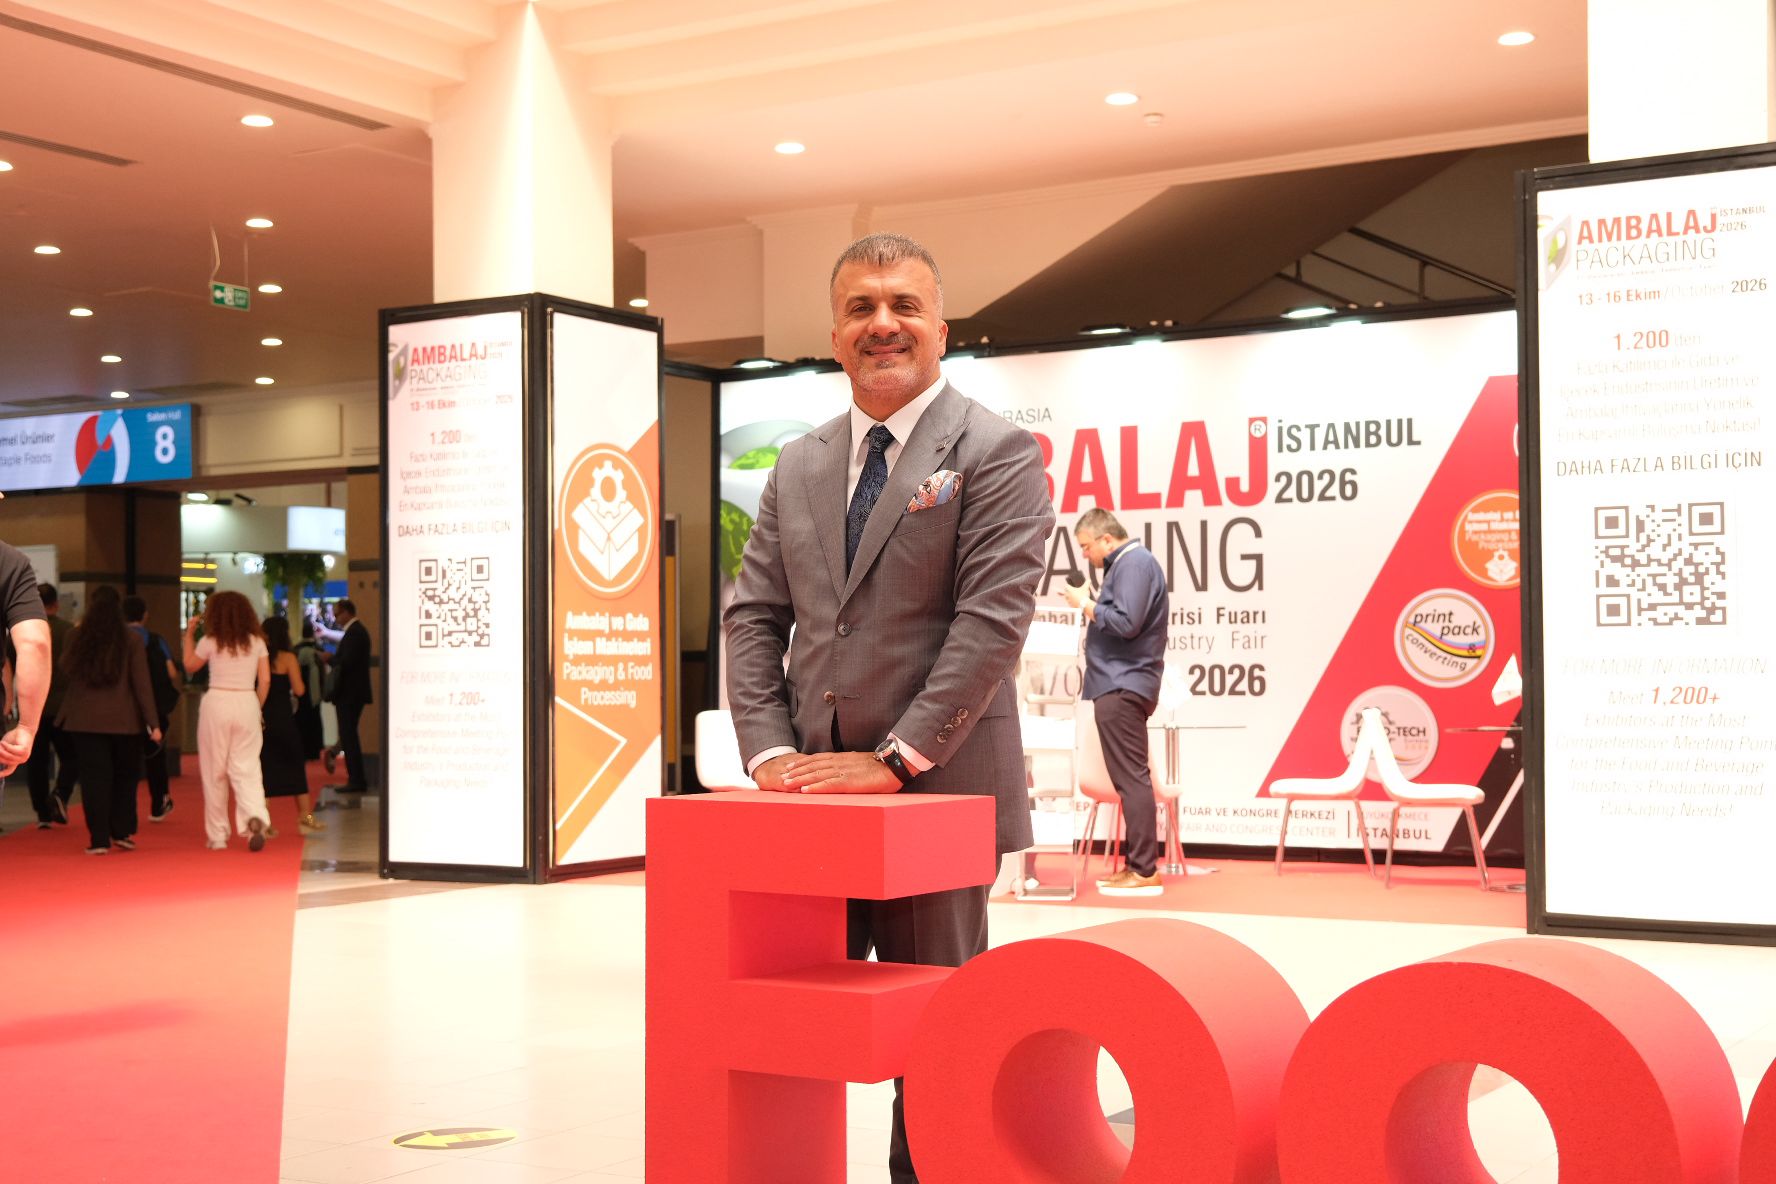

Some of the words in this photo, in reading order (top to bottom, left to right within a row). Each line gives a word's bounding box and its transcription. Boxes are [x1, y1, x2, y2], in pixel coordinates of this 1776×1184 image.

[1577, 209, 1717, 245] AMBALAJ
[1719, 221, 1747, 233] 2026
[1576, 237, 1716, 271] PACKAGING
[1577, 292, 1594, 306] 13
[1606, 290, 1622, 304] 16
[1731, 277, 1767, 294] 2026
[1614, 329, 1670, 351] 1.200
[411, 342, 488, 366] AMBALAJ
[1000, 407, 1053, 424] RASIA
[154, 424, 176, 464] 8
[1276, 417, 1422, 453] İSTANBUL
[1556, 459, 1604, 476] DAHA
[1610, 456, 1665, 474] FAZLA
[1274, 467, 1359, 505] 2026
[398, 522, 425, 538] DAHA
[428, 521, 458, 536] FAZLA
[611, 616, 625, 631] ve
[1413, 609, 1454, 626] print
[1440, 621, 1481, 640] pack
[1167, 632, 1215, 655] ustry
[1231, 630, 1267, 650] Fair
[1405, 632, 1467, 672] converting
[563, 661, 614, 684] Packaging
[617, 661, 626, 681] &
[627, 661, 653, 681] Food
[1188, 663, 1266, 697] 2026
[580, 687, 637, 709] Processing
[1182, 805, 1212, 817] FUAR
[1215, 806, 1229, 818] VE
[1232, 807, 1279, 819] KONGRE
